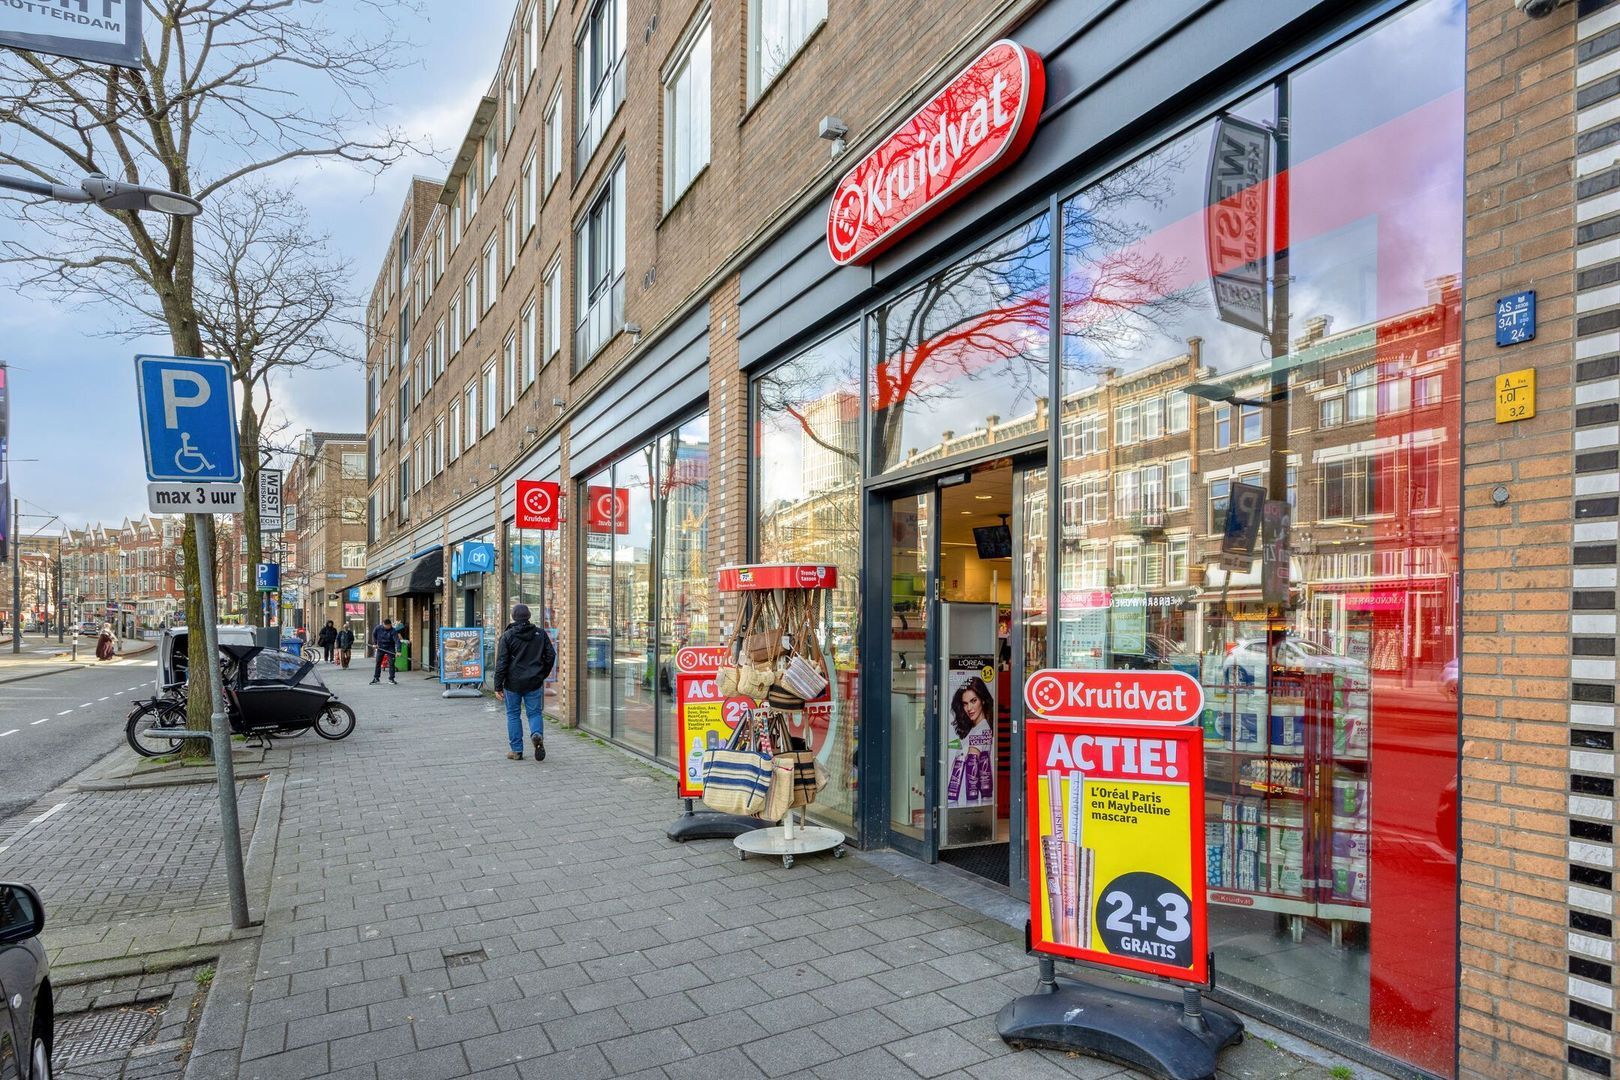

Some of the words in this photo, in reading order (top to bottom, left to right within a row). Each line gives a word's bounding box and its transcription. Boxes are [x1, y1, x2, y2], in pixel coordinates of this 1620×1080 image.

[867, 71, 1008, 224] Kruidvat
[1499, 301, 1512, 313] AS
[1505, 378, 1511, 388] A
[161, 369, 211, 429] P
[156, 490, 191, 505] max
[196, 488, 205, 504] 3
[211, 490, 236, 505] uur
[524, 514, 551, 523] Kruidvat
[258, 565, 268, 577] P
[1067, 681, 1188, 711] Kruidvat
[1046, 734, 1179, 778] ACTIE!
[1091, 787, 1129, 800] L'Oréal
[1132, 791, 1162, 803] Paris
[1091, 800, 1105, 809] en
[1107, 800, 1171, 816] Maybelline
[1091, 812, 1138, 824] mascara
[1220, 895, 1251, 905] Kruidvat
[1105, 890, 1191, 942] 2+3
[1120, 935, 1176, 960] GRATIS
